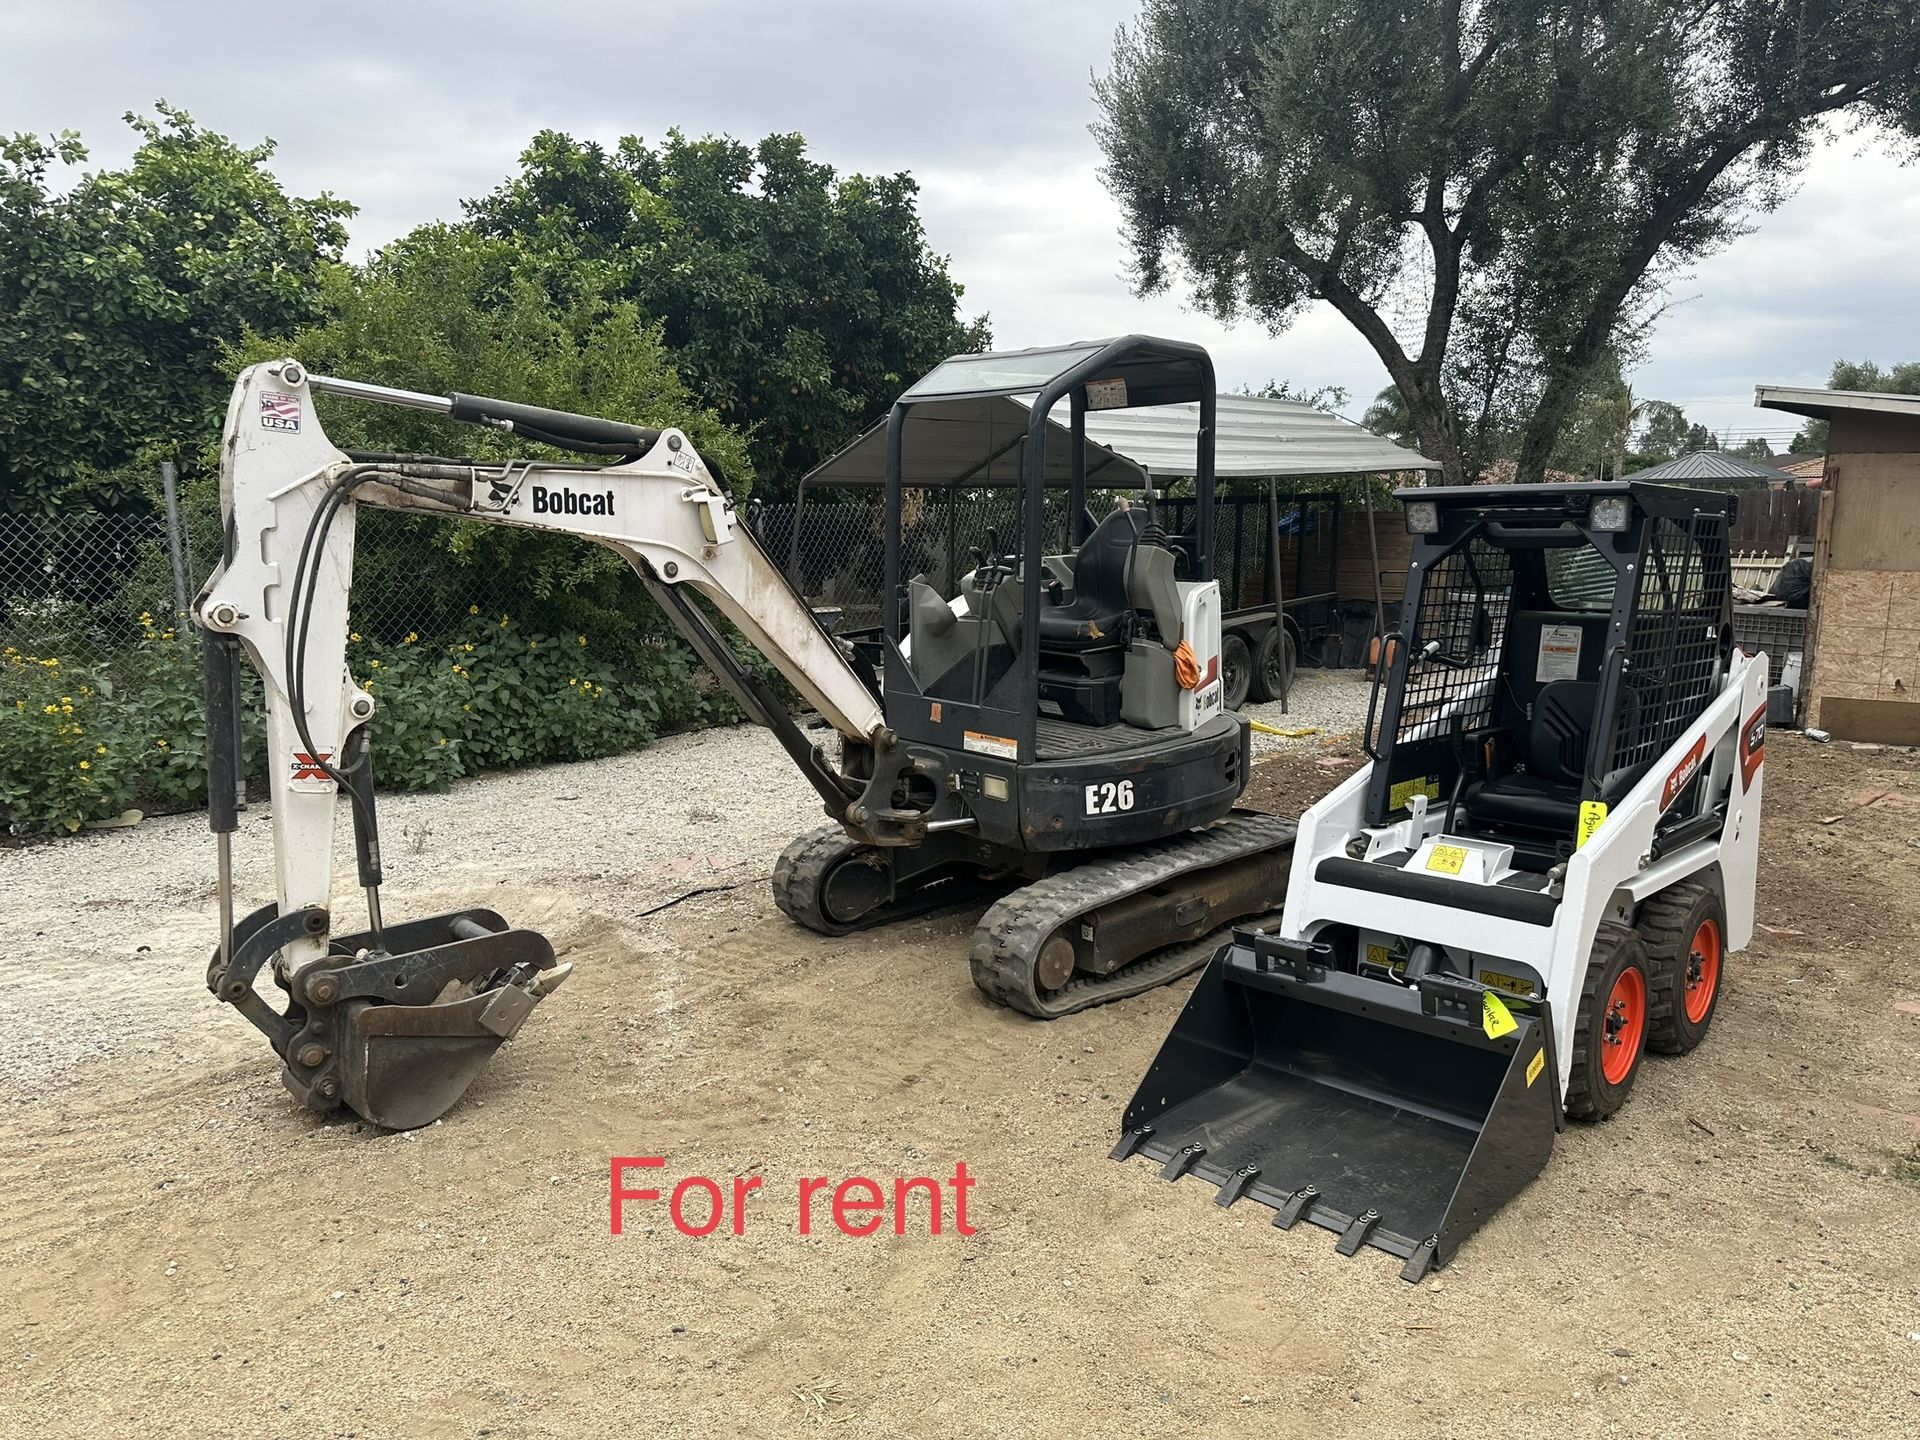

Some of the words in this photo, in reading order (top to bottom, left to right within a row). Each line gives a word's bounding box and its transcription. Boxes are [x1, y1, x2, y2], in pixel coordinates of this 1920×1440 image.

[263, 417, 297, 430] USA
[532, 486, 615, 516] Bobcat
[1085, 780, 1134, 815] E26
